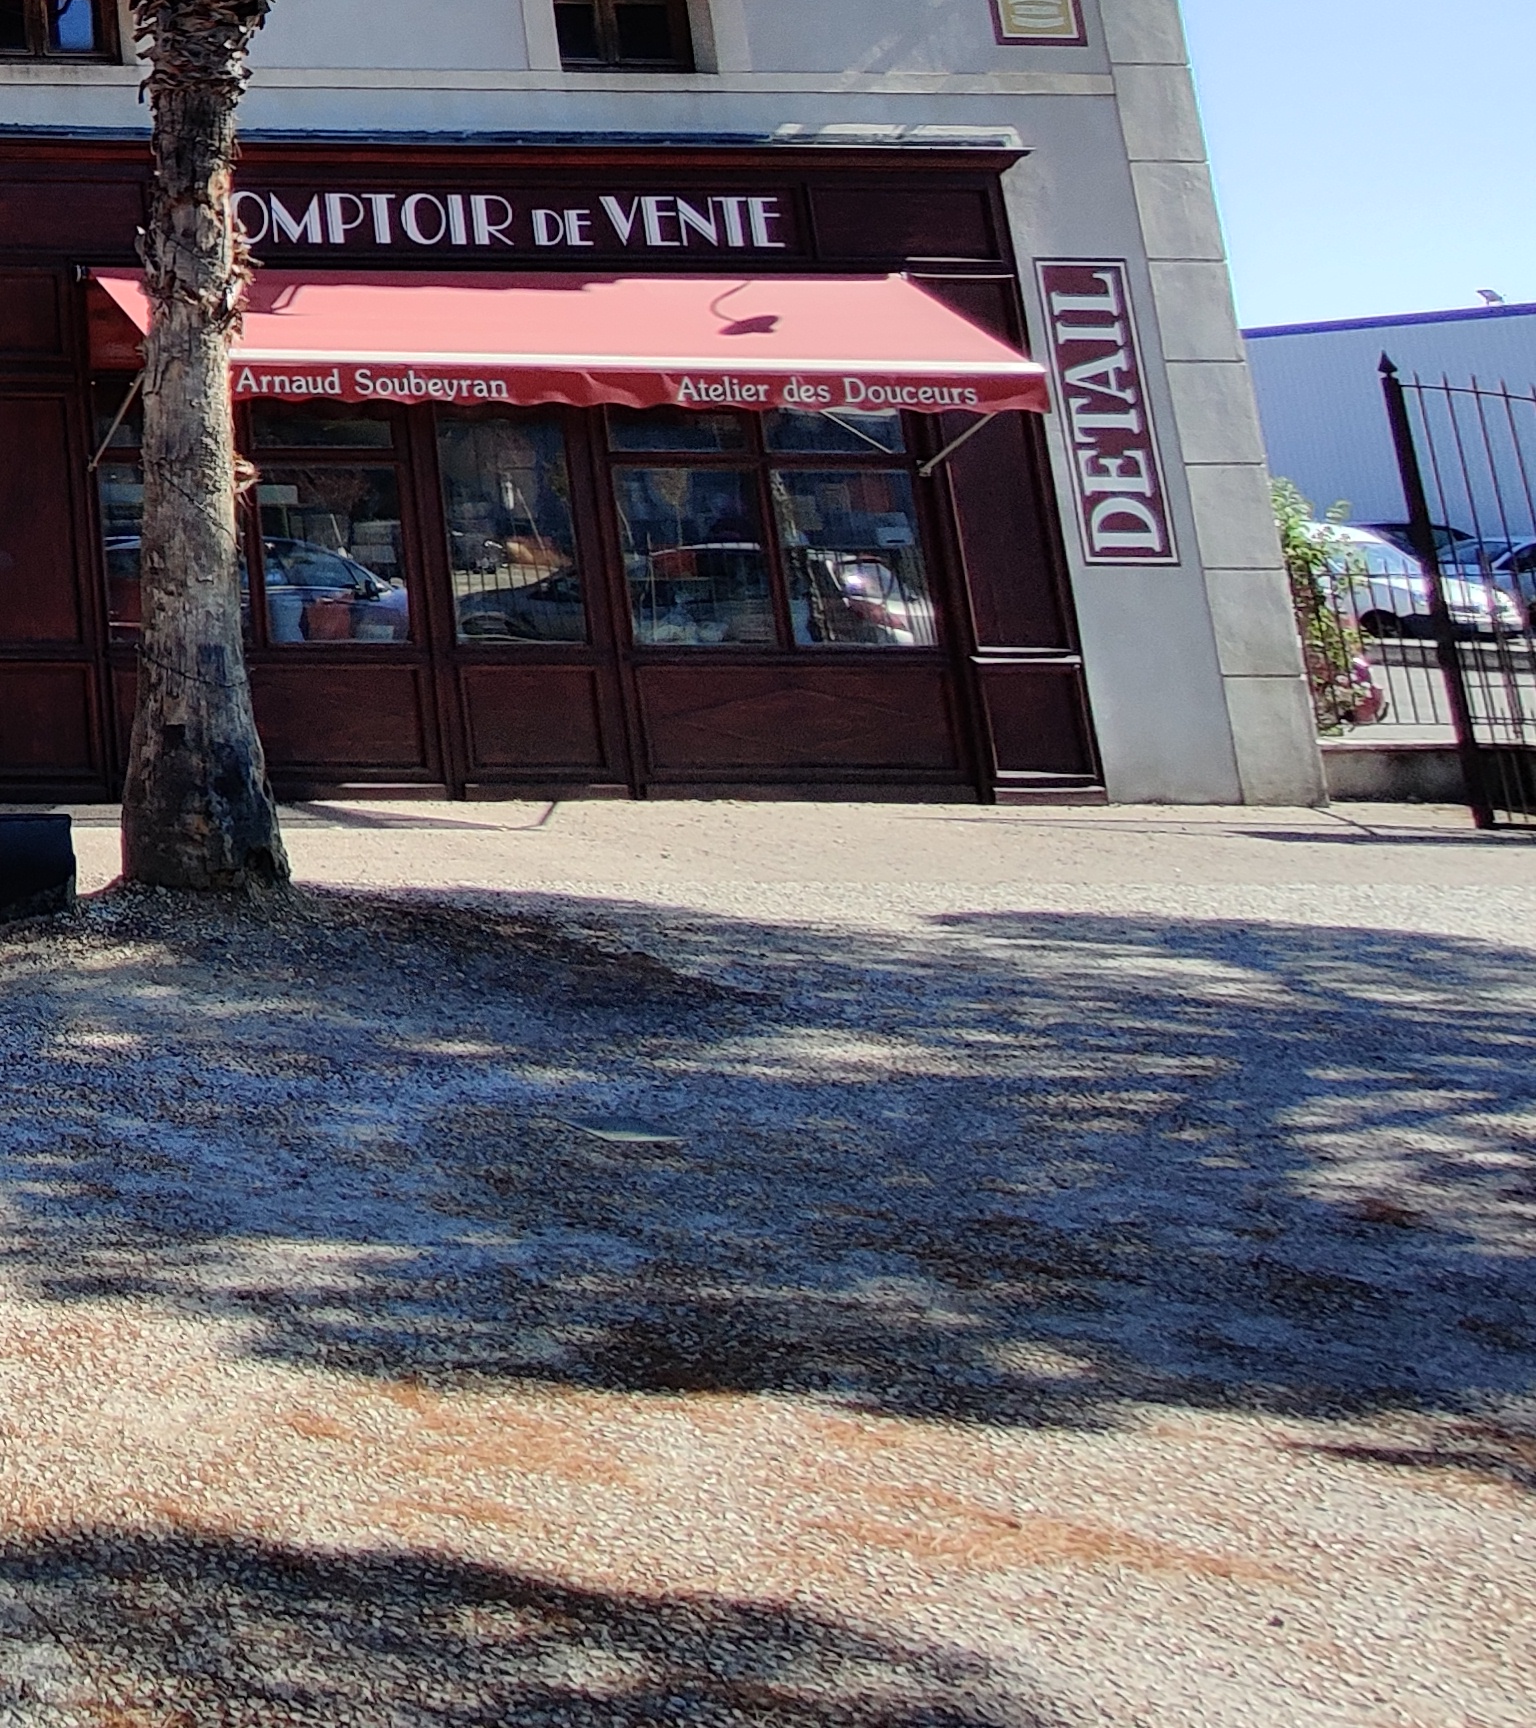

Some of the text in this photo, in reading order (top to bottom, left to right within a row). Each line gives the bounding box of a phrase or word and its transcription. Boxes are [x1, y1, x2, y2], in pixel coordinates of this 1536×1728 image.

[230, 190, 786, 249] OMPTOIR DE VENTE
[236, 367, 509, 400] Arnaud Soubeyran
[677, 376, 979, 406] Atelier des Douceurs
[1049, 271, 1163, 553] DETAIL
